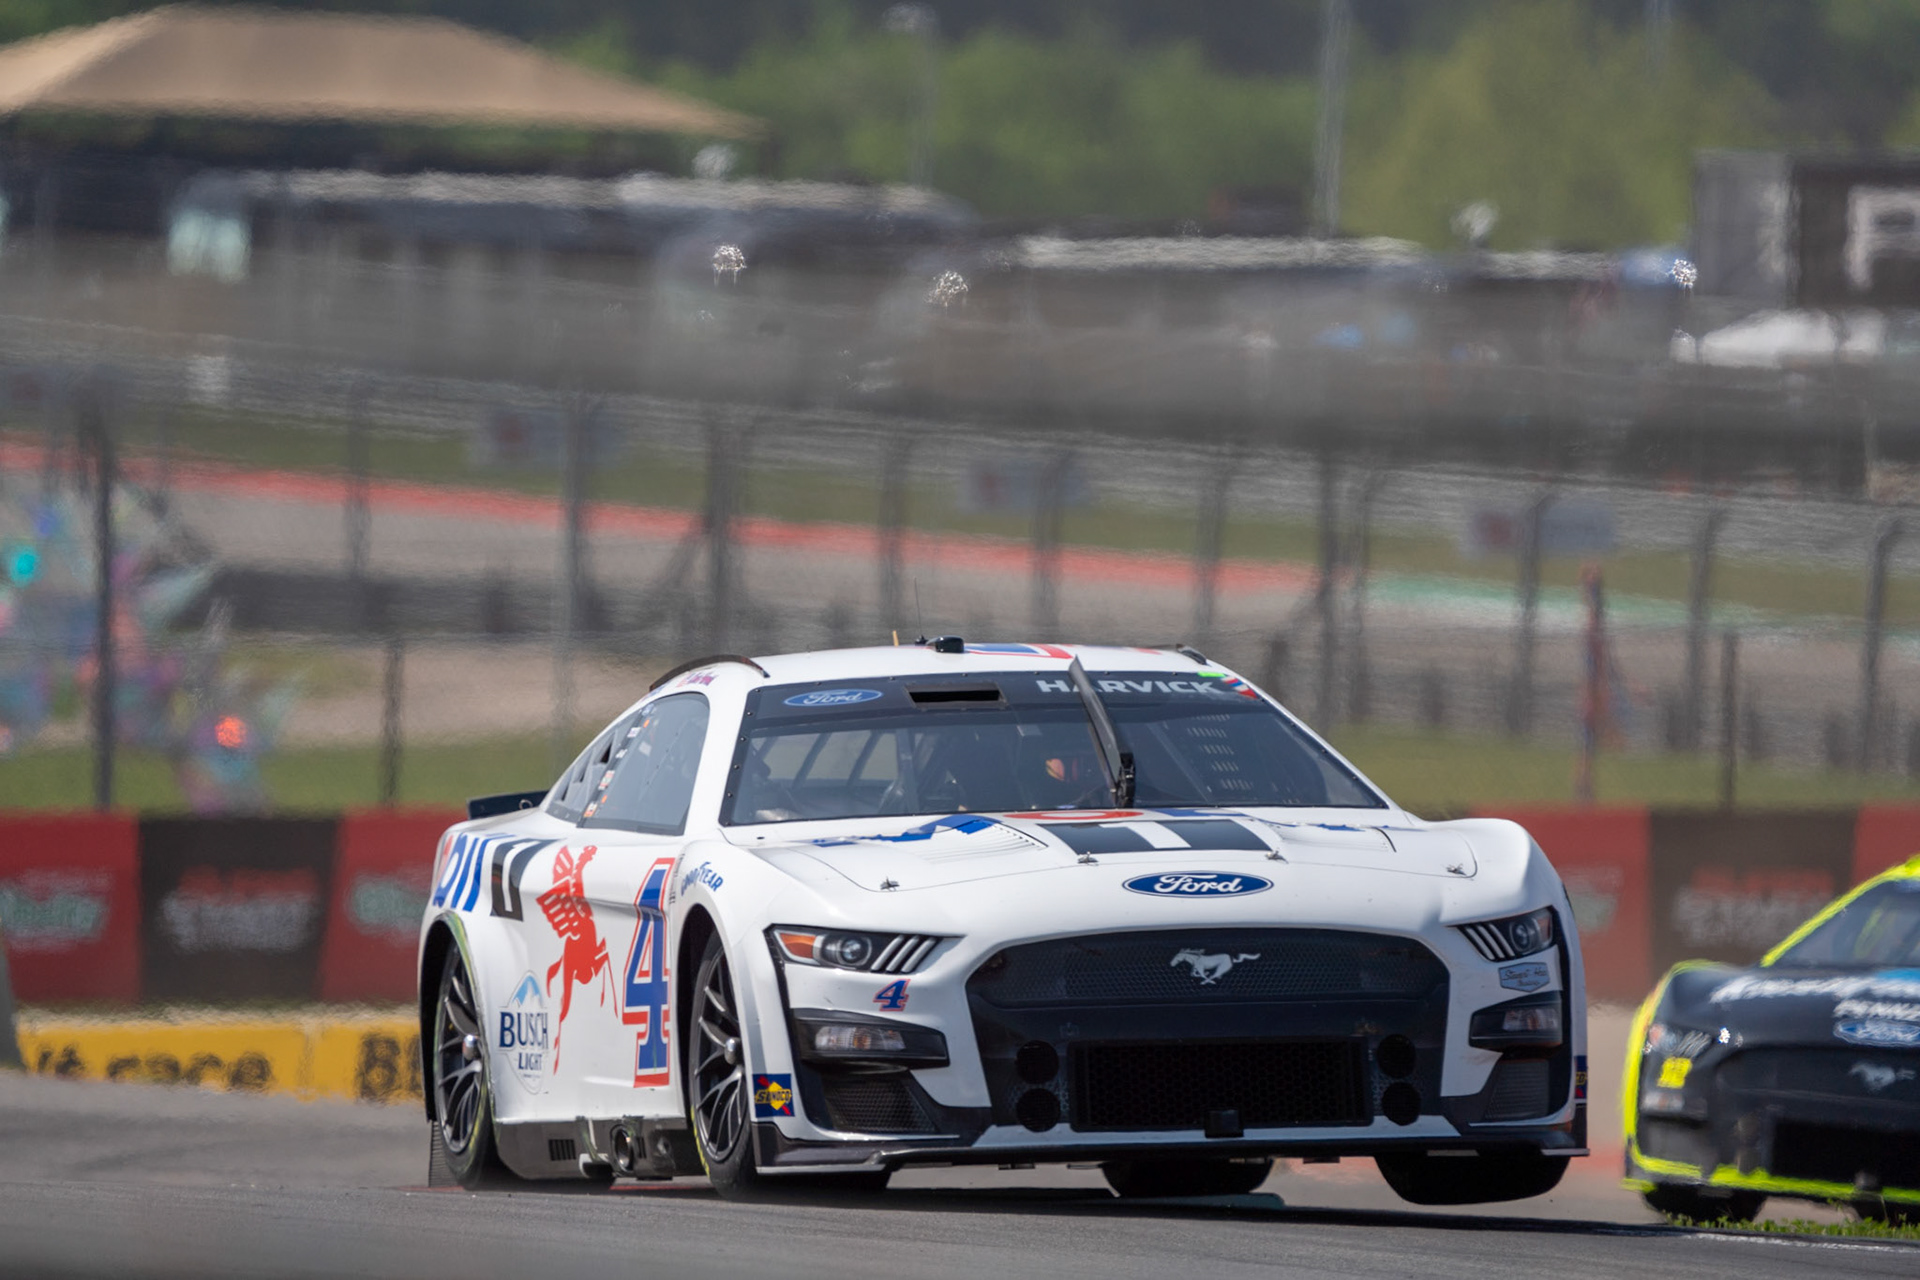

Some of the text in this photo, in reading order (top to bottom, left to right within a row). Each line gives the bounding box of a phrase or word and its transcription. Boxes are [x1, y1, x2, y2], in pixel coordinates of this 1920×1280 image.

[803, 690, 864, 705] Ford
[1153, 873, 1244, 894] Ford
[622, 857, 677, 1089] 4
[873, 979, 911, 1012] 4
[499, 1011, 549, 1050] BUSCH
[518, 1052, 542, 1071] LIGHT
[756, 1089, 792, 1104] SUNOCO
